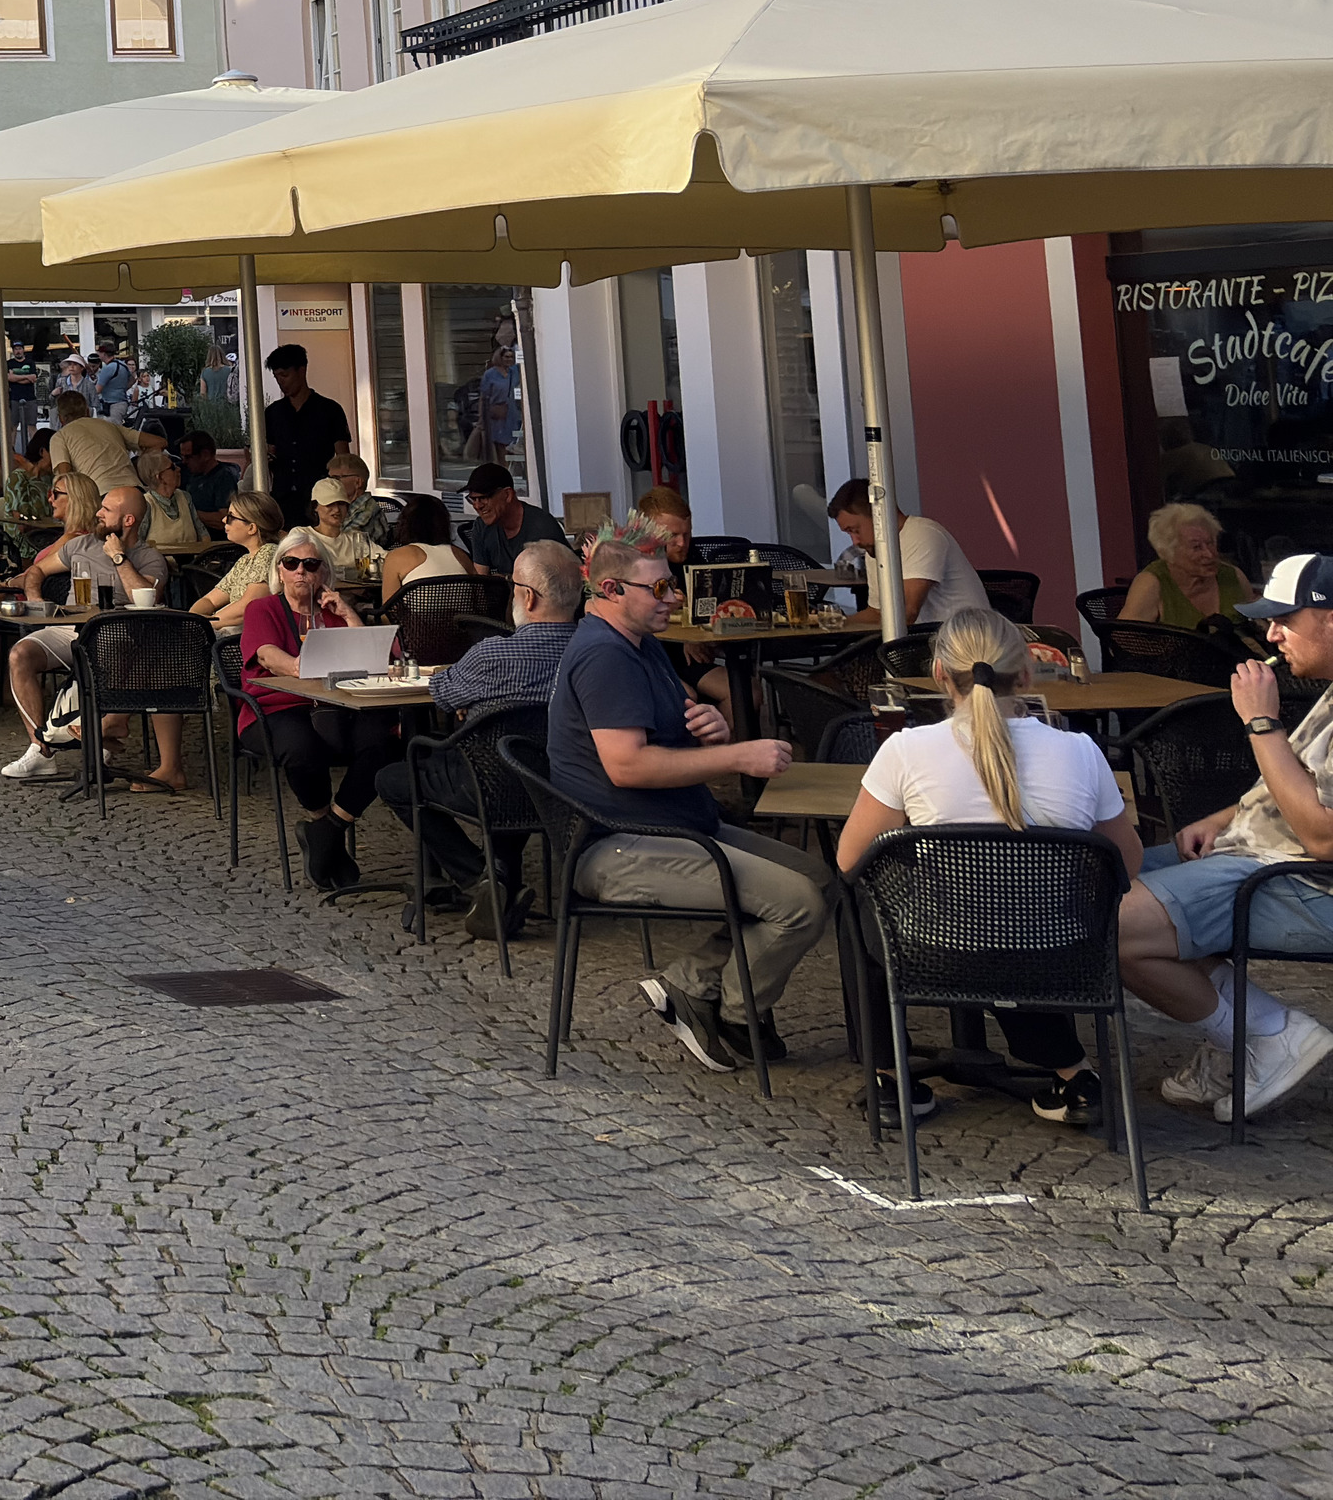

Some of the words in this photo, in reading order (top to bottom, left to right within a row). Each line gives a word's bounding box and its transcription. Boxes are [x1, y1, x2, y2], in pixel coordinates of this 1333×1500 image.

[1117, 275, 1266, 312] RISTORANTE
[289, 308, 343, 316] INTERSPORT
[1225, 381, 1269, 407] Dolce
[1276, 382, 1308, 406] Vita
[1210, 448, 1264, 462] ORIGINAL
